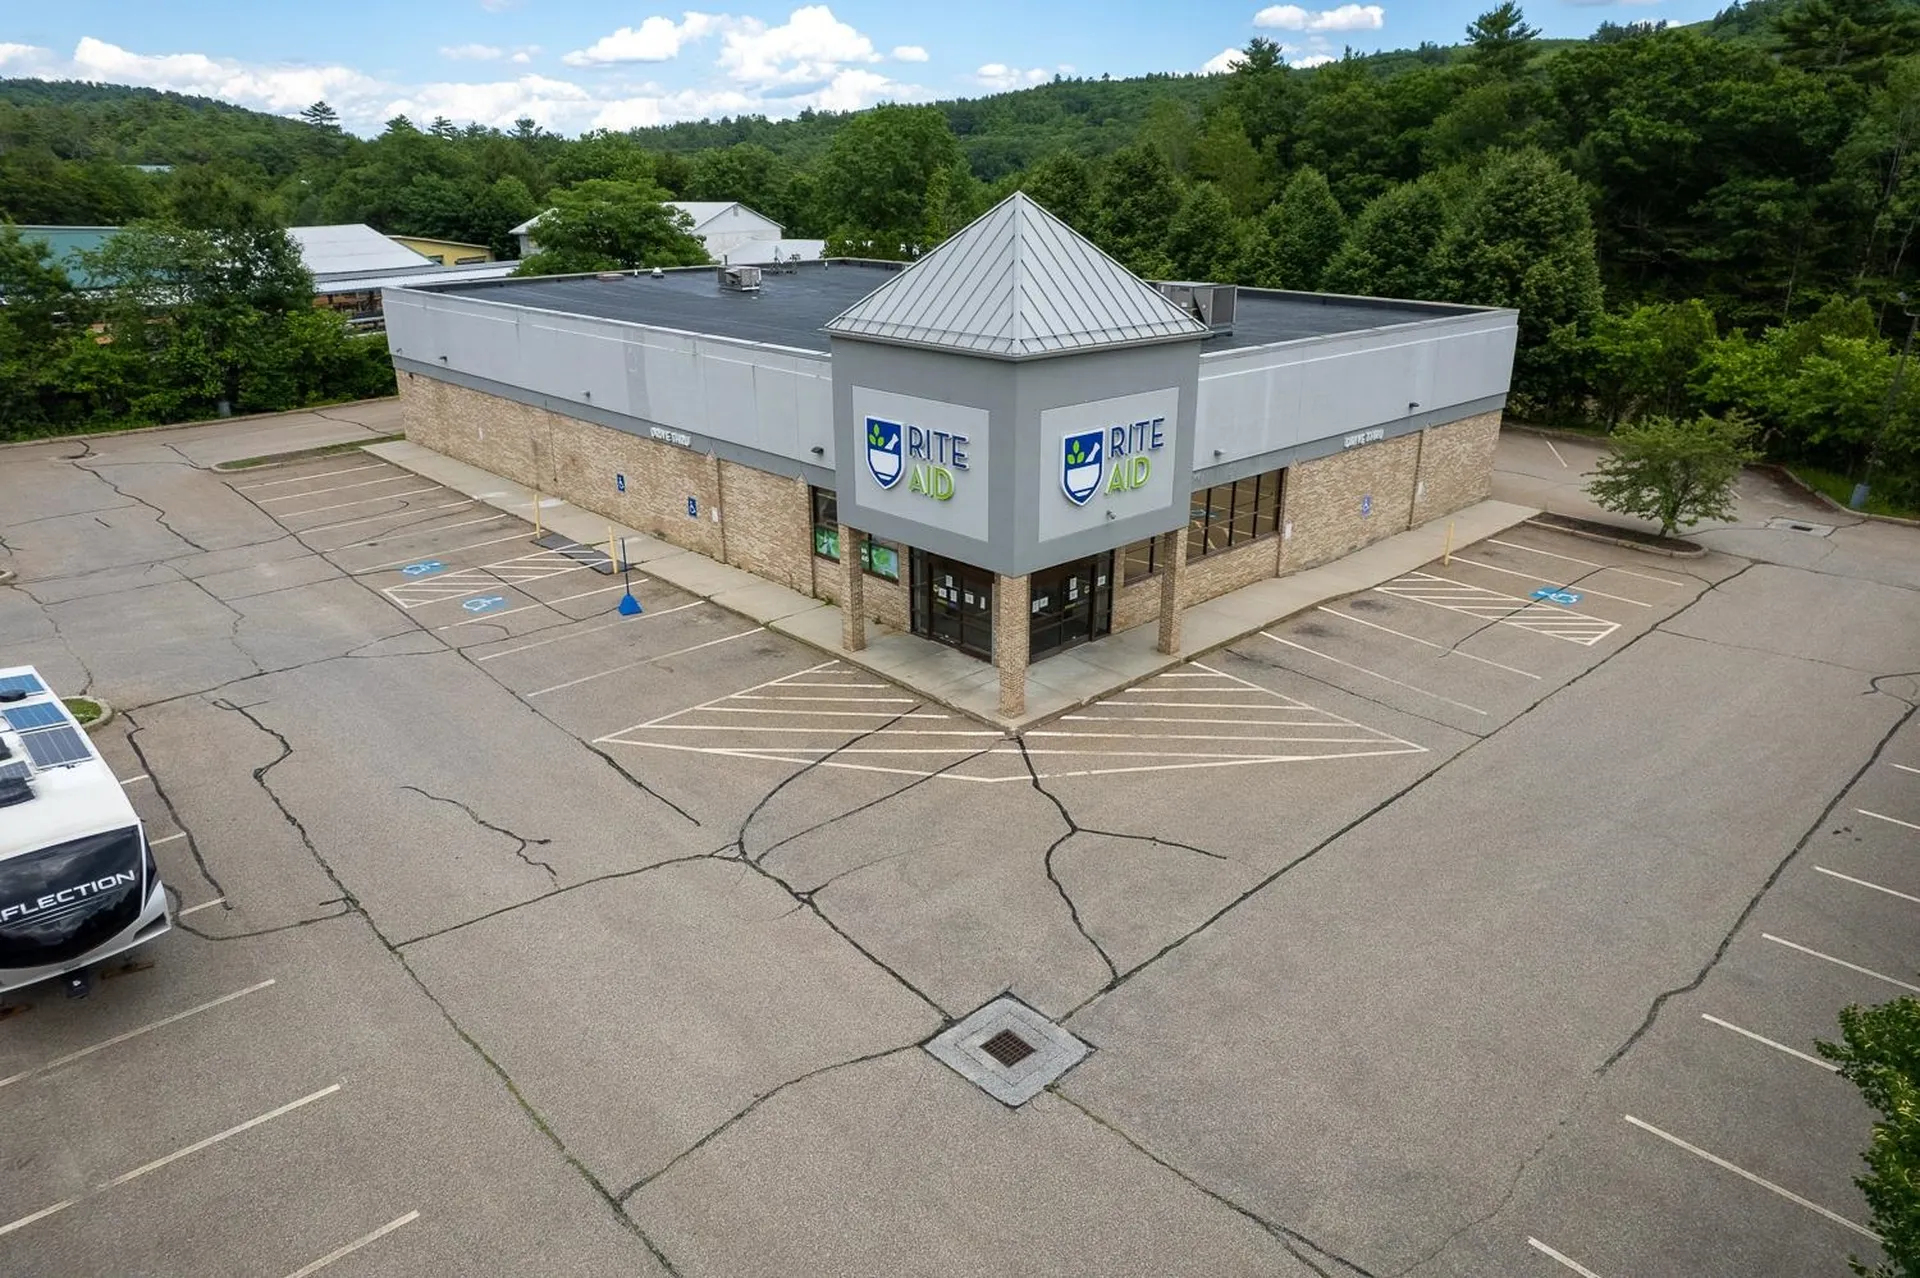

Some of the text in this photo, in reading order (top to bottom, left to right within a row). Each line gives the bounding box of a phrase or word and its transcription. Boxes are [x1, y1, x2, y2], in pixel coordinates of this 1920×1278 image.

[908, 425, 969, 471] RITE
[1108, 418, 1165, 458] RITE
[908, 463, 955, 501] AID
[1105, 456, 1151, 494] AID
[0, 869, 136, 922] FLECTION
